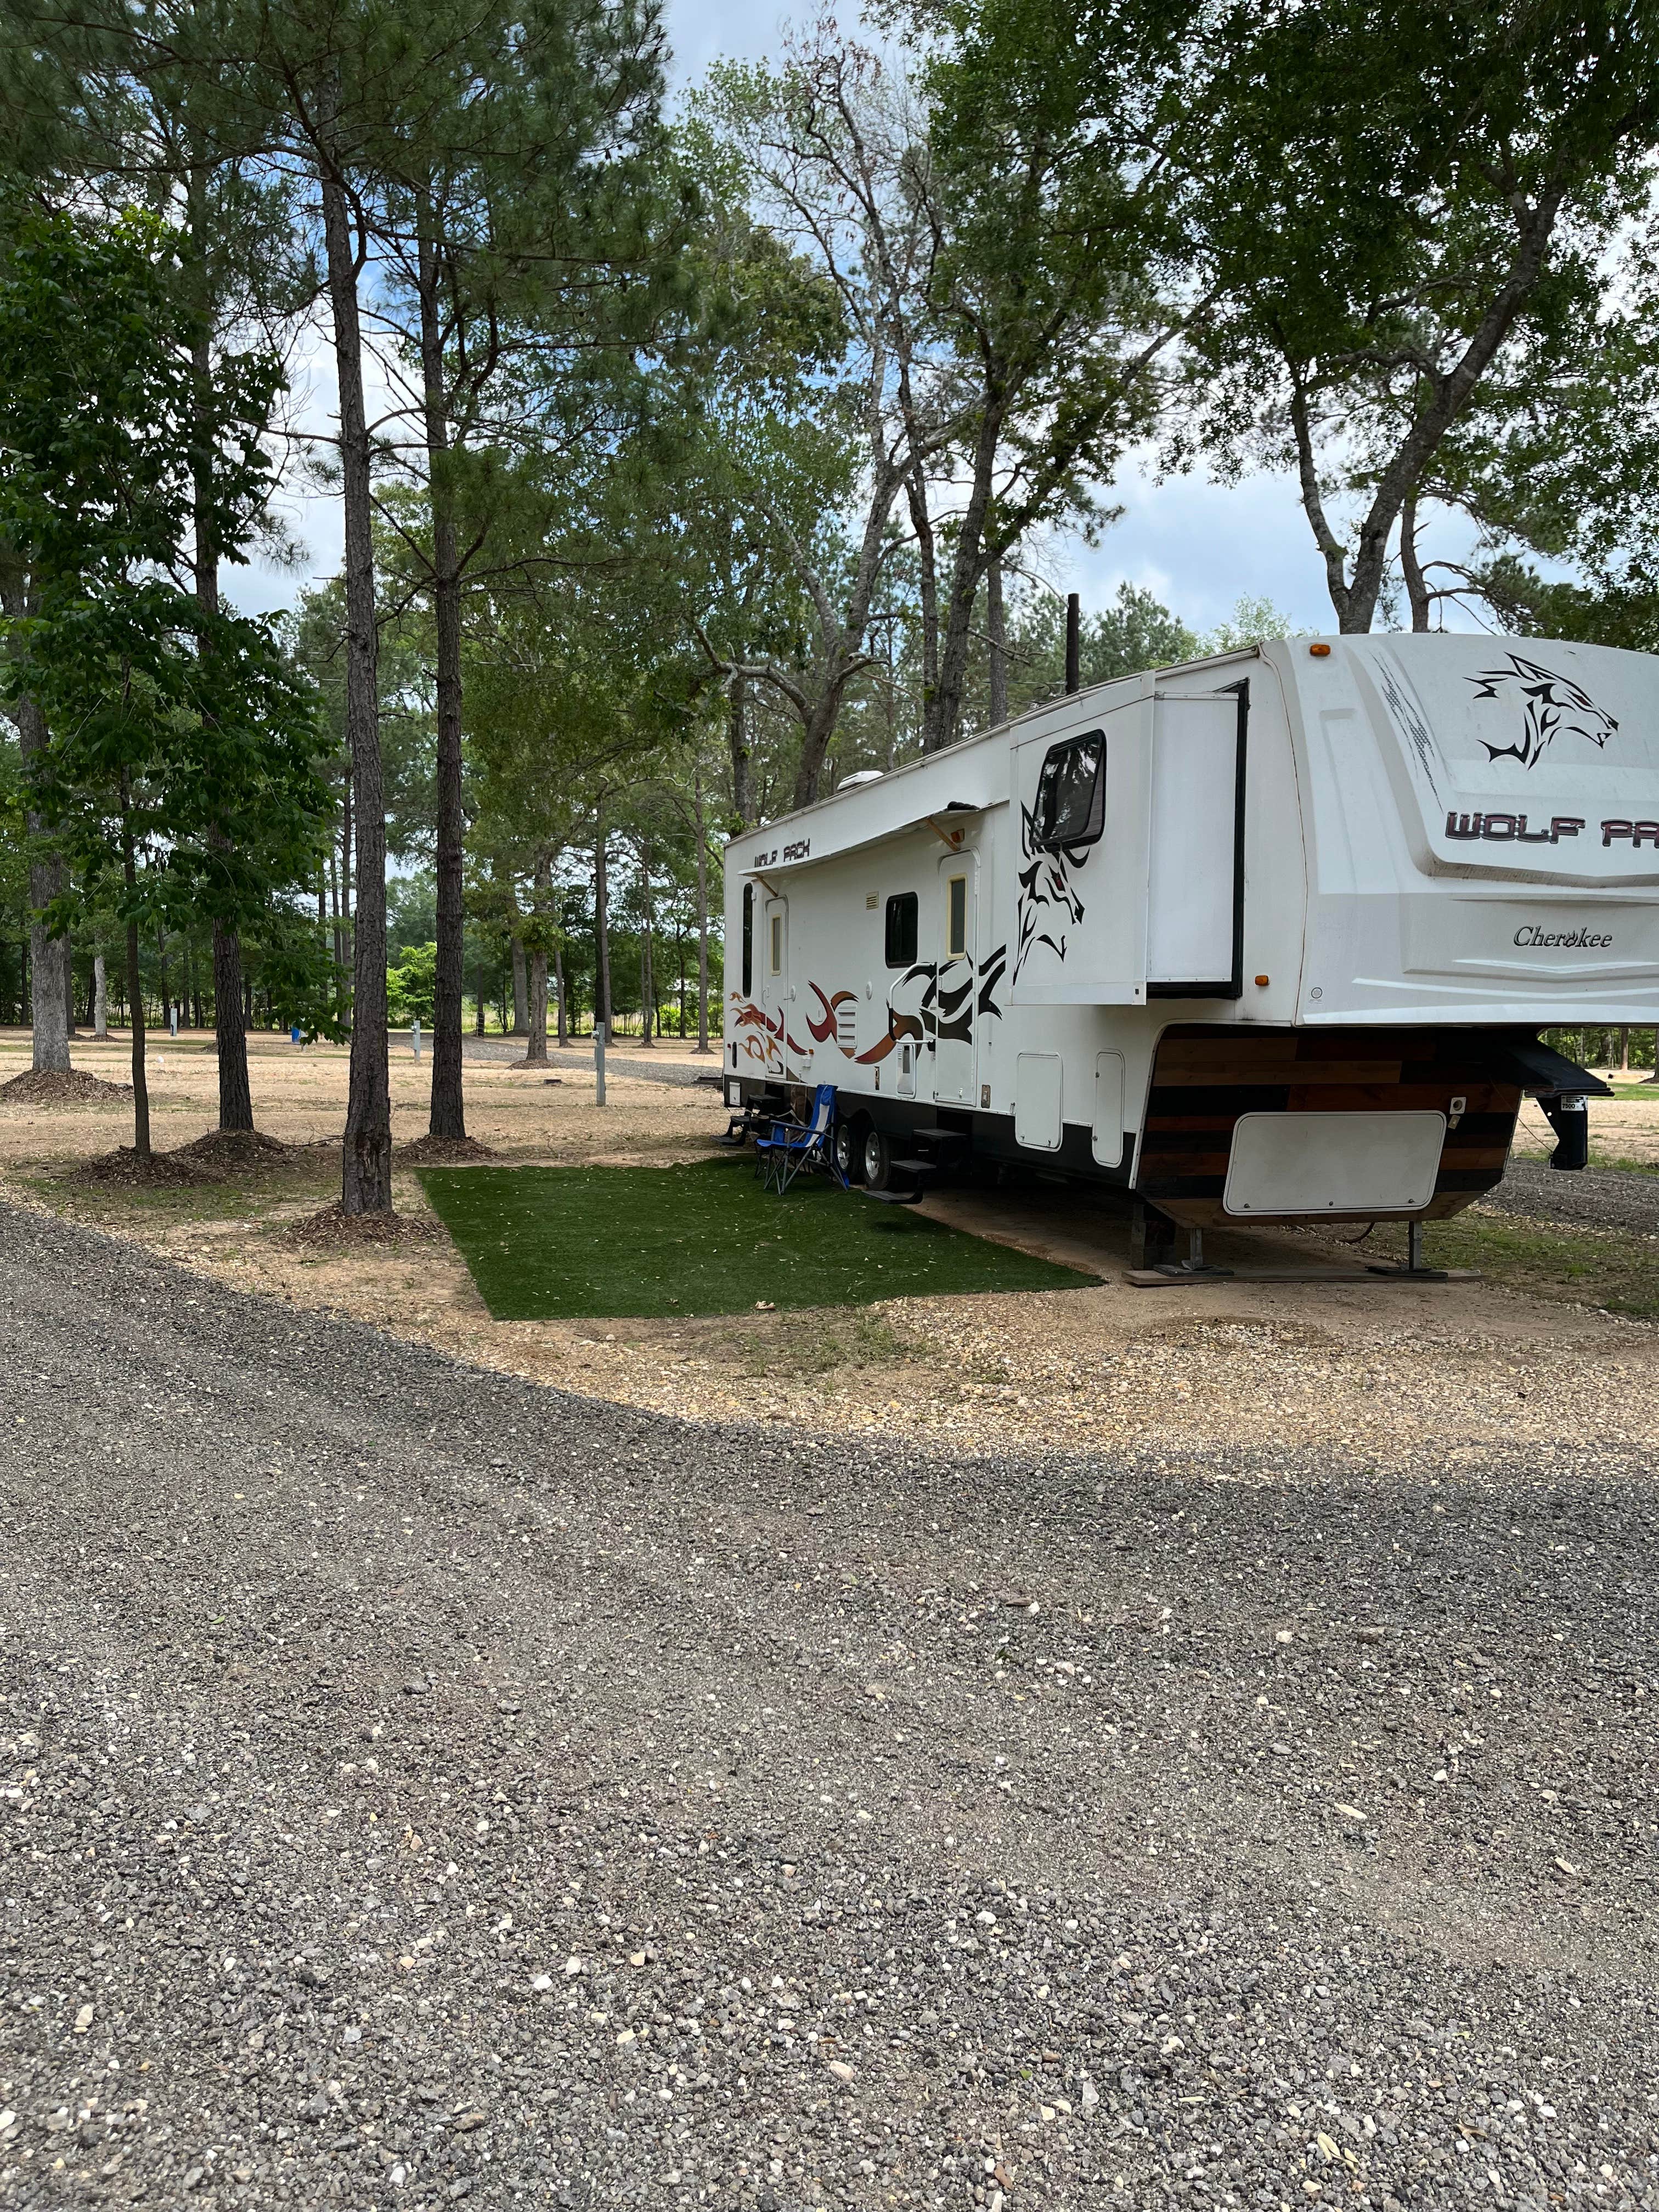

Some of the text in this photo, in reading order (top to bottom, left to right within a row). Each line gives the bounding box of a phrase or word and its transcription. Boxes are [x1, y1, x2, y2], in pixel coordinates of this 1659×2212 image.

[1445, 811, 1586, 844] WOLF
[754, 838, 810, 867] WOLF PACK
[1513, 926, 1612, 947] Cherokee
